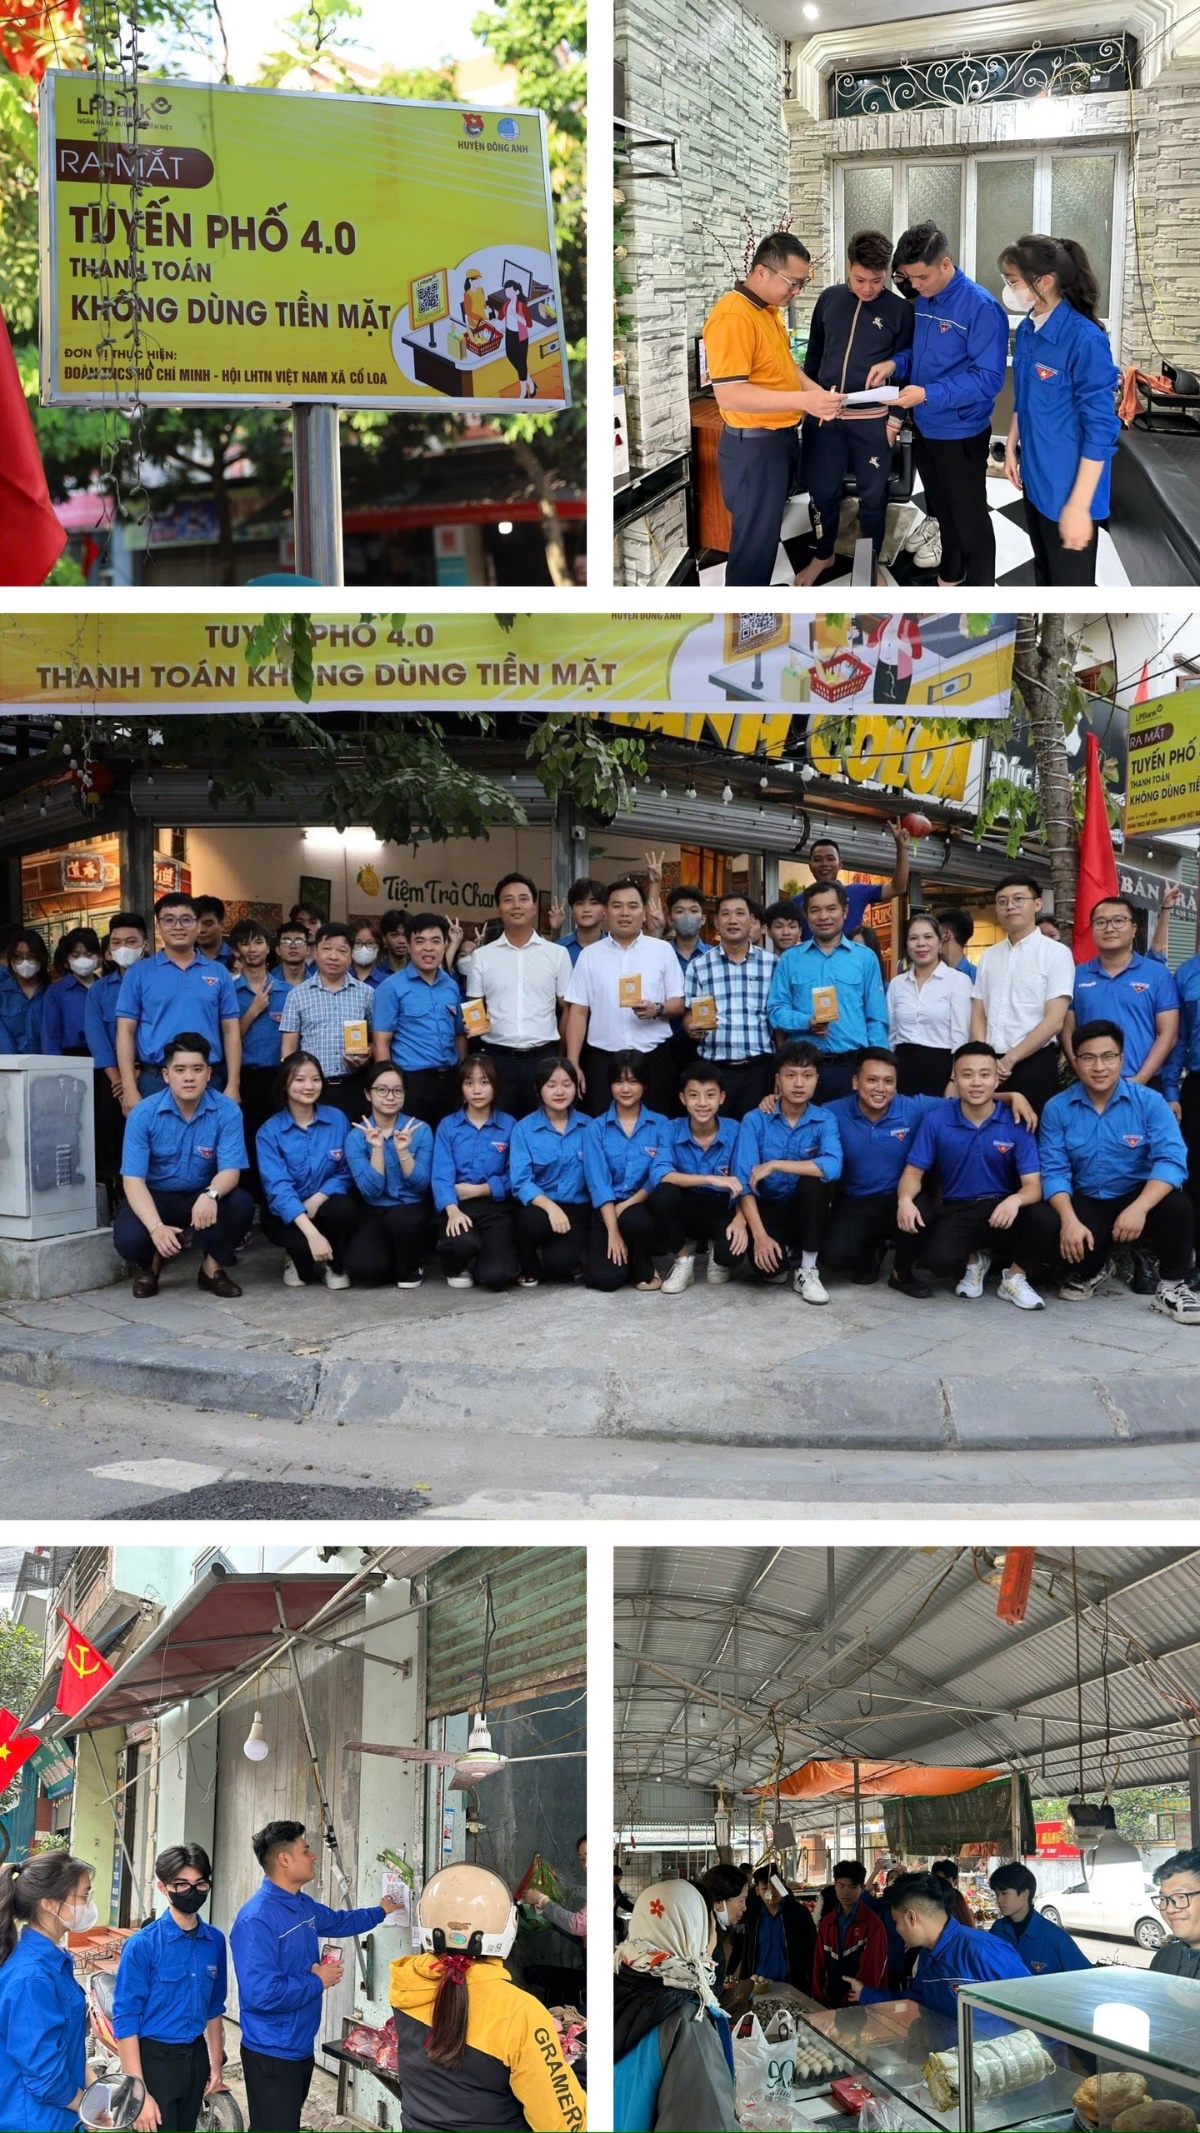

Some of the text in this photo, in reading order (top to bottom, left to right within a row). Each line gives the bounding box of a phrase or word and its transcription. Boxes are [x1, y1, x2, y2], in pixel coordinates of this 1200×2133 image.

[77, 97, 151, 119] LPBank
[457, 140, 528, 153] HUYỆN ĐÔNG ANH
[60, 148, 184, 180] RA MẮT
[69, 195, 356, 255] TUYẾN PHỐ 4.0
[69, 257, 211, 283] THANH TOÁN
[71, 289, 391, 337] KHÔNG DÙNG TIỀN MẶT
[64, 348, 92, 358] ĐƠN
[64, 364, 99, 379] ĐOÀN
[156, 366, 176, 381] CHÍ
[179, 369, 210, 382] MINH
[222, 367, 241, 384] HỘI
[244, 370, 272, 383] LHTN
[275, 368, 298, 386] VIỆT
[302, 371, 328, 384] NAM
[331, 369, 346, 384] XÃ
[350, 367, 364, 384] CỔ
[367, 372, 387, 384] LOA
[387, 623, 434, 648] 4.0
[36, 651, 617, 692] THANH TOÁN KHNG DÙNG TIỀN MẶT
[1130, 735, 1143, 748] RA
[1131, 736, 1197, 775] TUYẾN PHỐ
[1131, 771, 1171, 789] THANH TOÁN
[1130, 790, 1159, 806] KHÔNG
[1161, 783, 1186, 799] DÙNG
[383, 876, 424, 908] Tiệm
[424, 880, 459, 907] Trà
[1121, 876, 1160, 901] BÁN
